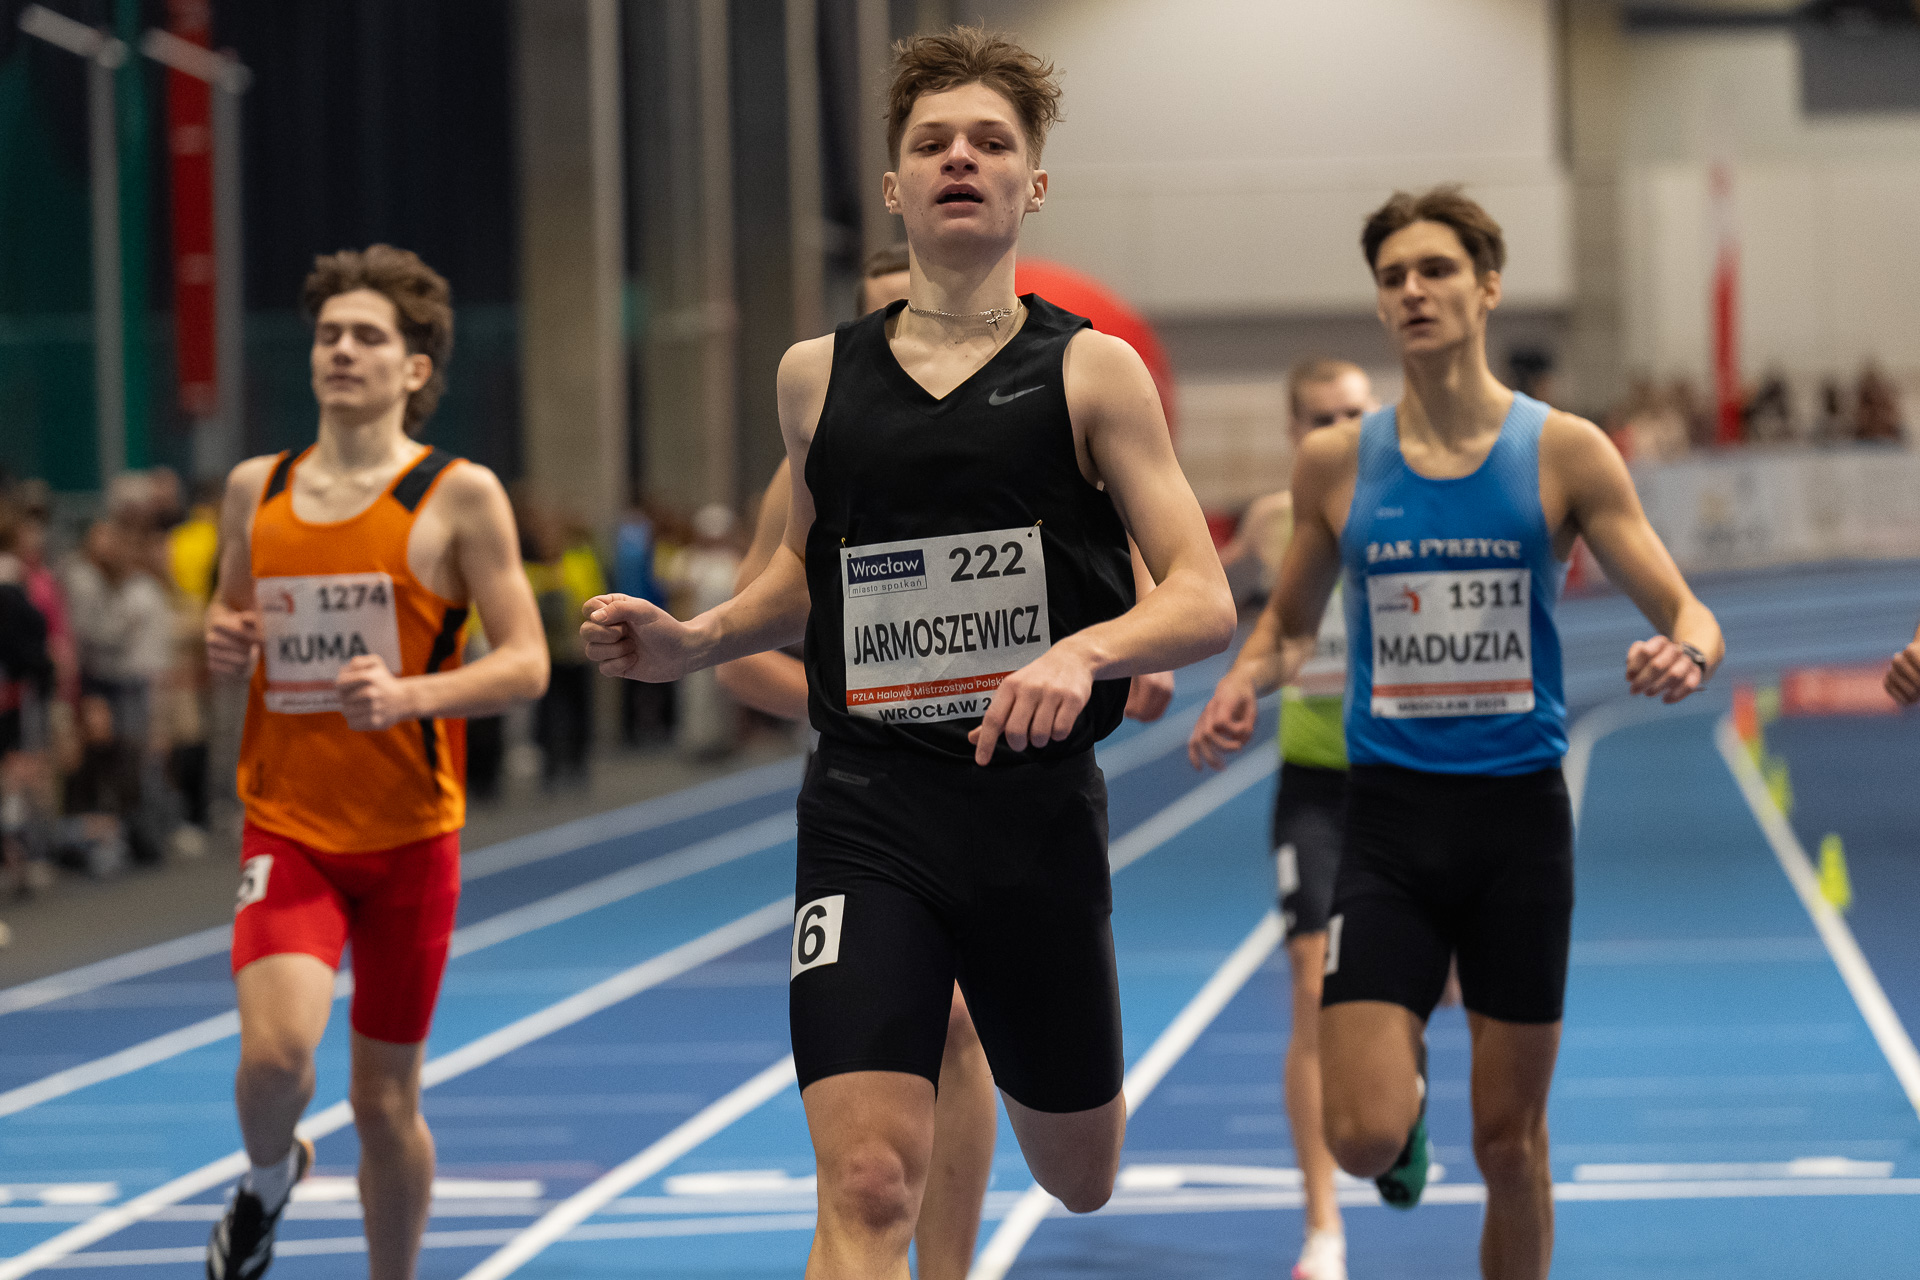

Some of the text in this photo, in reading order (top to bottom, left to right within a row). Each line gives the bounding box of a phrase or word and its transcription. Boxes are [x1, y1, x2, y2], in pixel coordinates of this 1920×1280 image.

[851, 558, 919, 578] Wrocław
[949, 541, 1026, 582] 222
[319, 582, 387, 611] 1274
[852, 578, 922, 595] miasto spotkań
[1449, 580, 1522, 609] 1311
[278, 632, 368, 663] KUMA
[853, 605, 1041, 665] JARMOSZEWICZ
[1378, 631, 1523, 666] MADUZIA
[852, 692, 875, 702] PZLA
[876, 686, 912, 700] Halowe
[914, 682, 974, 696] Mistrzostwa
[878, 699, 978, 722] WROCŁAW
[798, 905, 827, 965] 6
